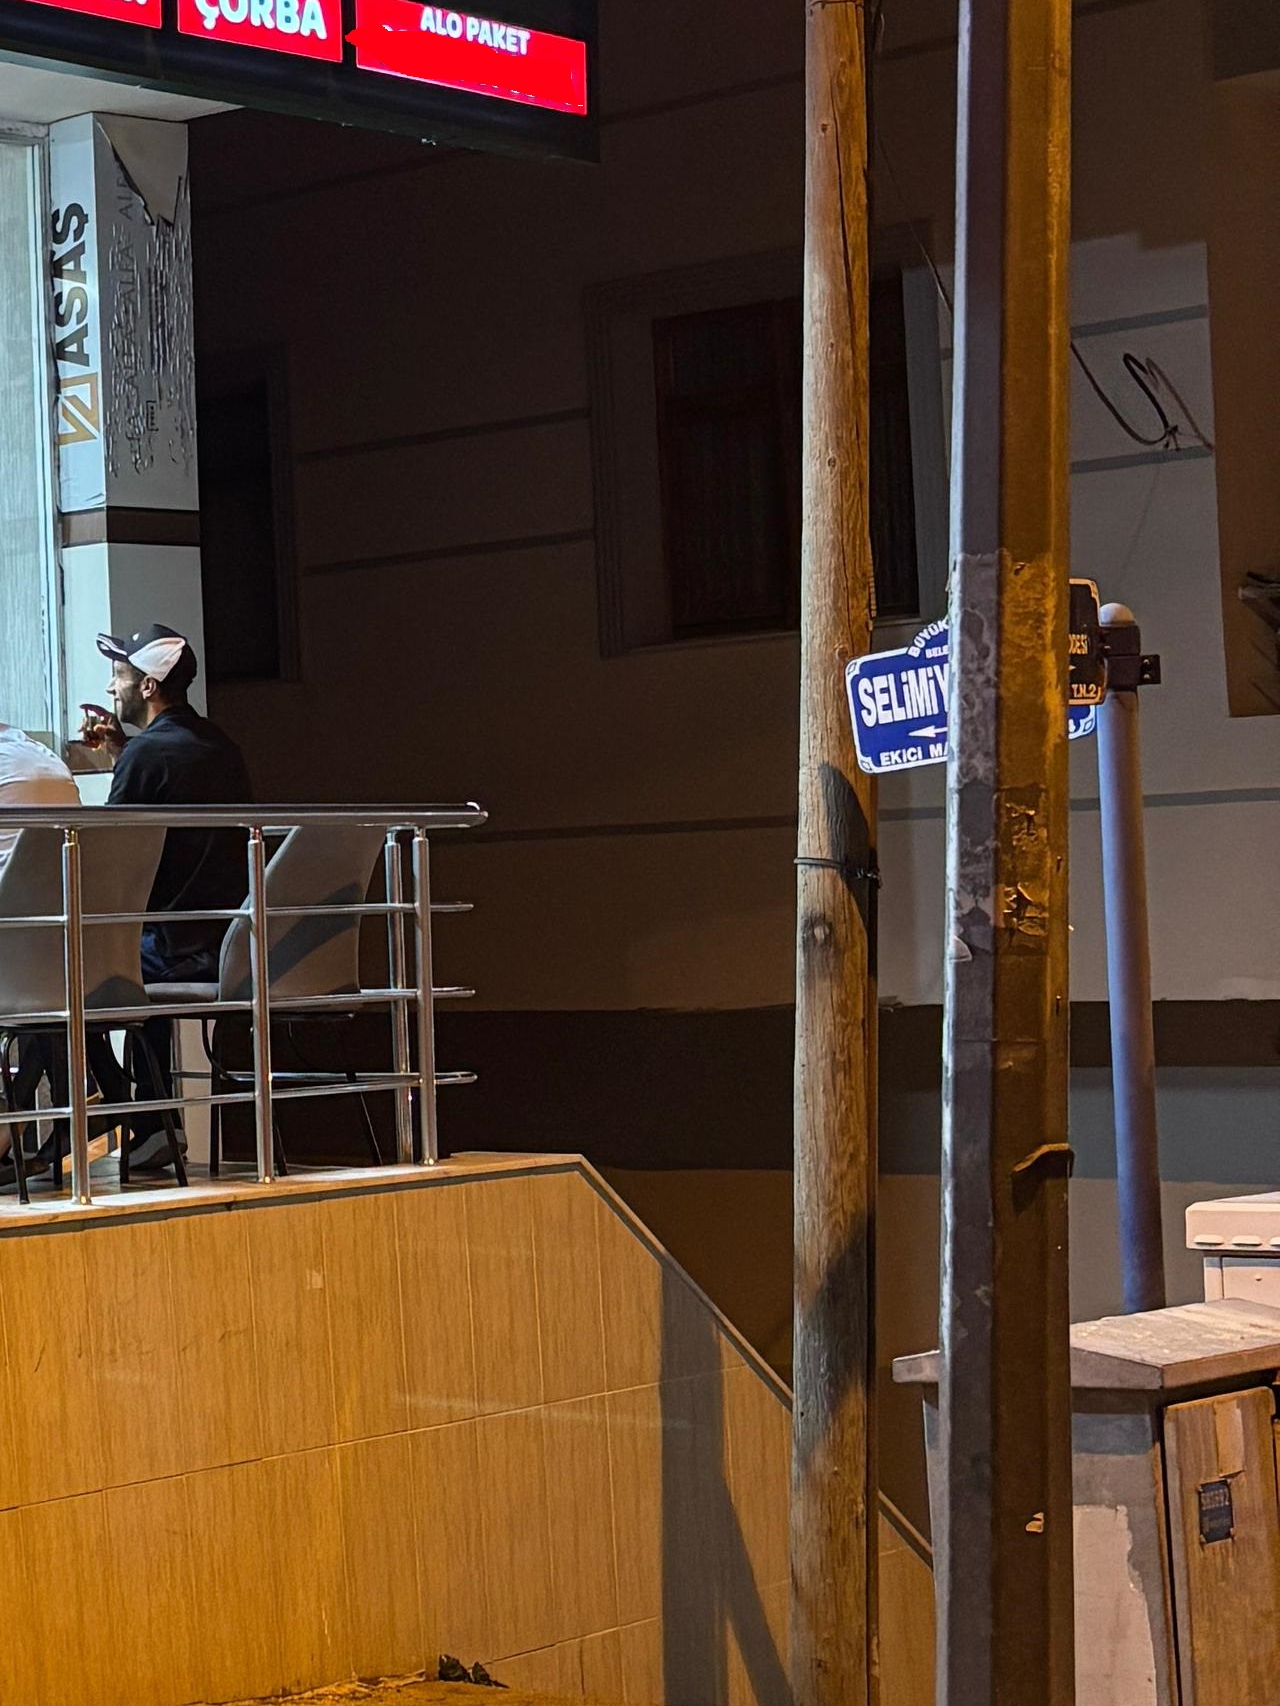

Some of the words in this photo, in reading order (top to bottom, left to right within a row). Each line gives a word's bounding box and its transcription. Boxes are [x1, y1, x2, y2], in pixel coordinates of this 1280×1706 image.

[419, 5, 464, 39] ALO
[465, 16, 531, 56] PAKET
[50, 201, 90, 368] ASAŞ
[857, 662, 949, 728] SELİMİY
